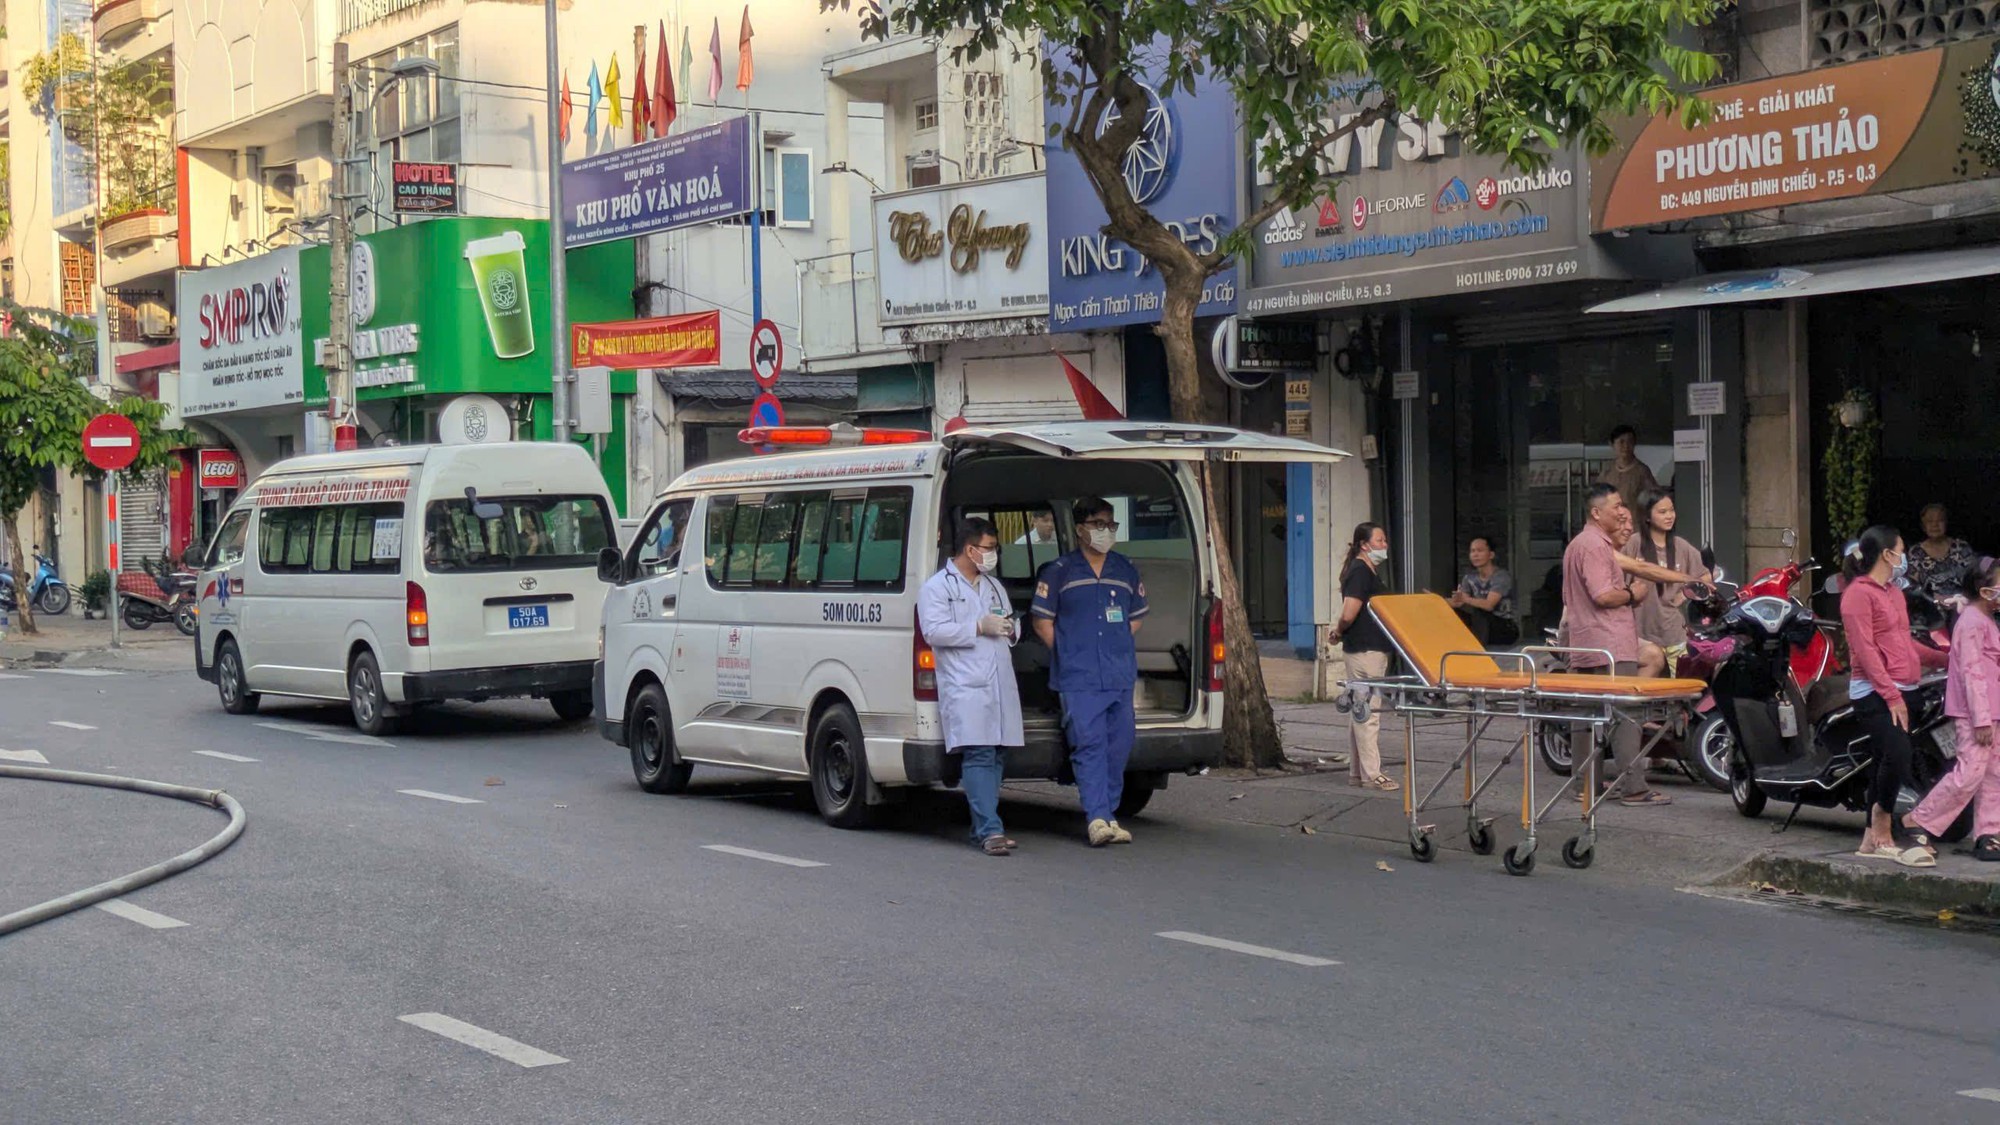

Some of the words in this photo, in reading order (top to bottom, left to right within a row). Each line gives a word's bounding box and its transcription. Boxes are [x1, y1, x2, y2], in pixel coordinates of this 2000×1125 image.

[1759, 89, 1790, 115] GIẢI
[1795, 84, 1835, 109] KHÁT
[1656, 131, 1783, 183] PHƯƠNG
[1792, 108, 1879, 162] THẢO
[395, 164, 454, 183] HOTEL
[625, 170, 638, 182] KHU
[640, 162, 654, 178] PHỐ
[655, 163, 665, 174] 25
[1497, 168, 1572, 196] manduka
[399, 185, 418, 195] CAO
[576, 199, 608, 228] KHU
[611, 180, 642, 220] PHỐ
[645, 179, 682, 213] VĂN
[686, 166, 722, 205] HOÁ
[1661, 194, 1679, 210] ĐC:
[1681, 191, 1701, 207] 449
[1704, 178, 1749, 202] NGUYỄN
[1751, 178, 1779, 197] ĐÌNH
[1782, 168, 1817, 193] CHIỂU
[1828, 169, 1845, 186] P.5
[1856, 164, 1876, 182] Q.3
[1368, 194, 1426, 215] LIFORME
[1264, 227, 1303, 244] adidas
[1061, 232, 1123, 277] KING
[1505, 267, 1532, 281] 0906
[1535, 264, 1553, 277] 737
[1556, 261, 1578, 275] 699
[1054, 303, 1077, 325] Ngọc
[1079, 296, 1100, 317] Cẩm
[1104, 294, 1130, 317] Thạch
[1134, 291, 1159, 312] Thiên
[1214, 280, 1235, 306] Cấp
[1247, 299, 1263, 311] 447
[1264, 291, 1300, 309] NGUYỄN
[1302, 289, 1324, 306] ĐÌNH
[1325, 282, 1355, 302] CHIỂU,
[1373, 284, 1392, 297] Q.3
[1288, 384, 1307, 395] 445
[204, 463, 235, 476] LEGO
[256, 487, 287, 506] TRUNG
[287, 482, 308, 505] TÂM
[307, 477, 328, 505] CẤP
[328, 479, 351, 502] CỨU
[352, 482, 369, 501] 115
[370, 479, 410, 500] TP.HCM
[512, 616, 545, 628] 017.69
[519, 607, 537, 617] 50A
[822, 602, 844, 622] 50M
[846, 603, 882, 623] 001.63
